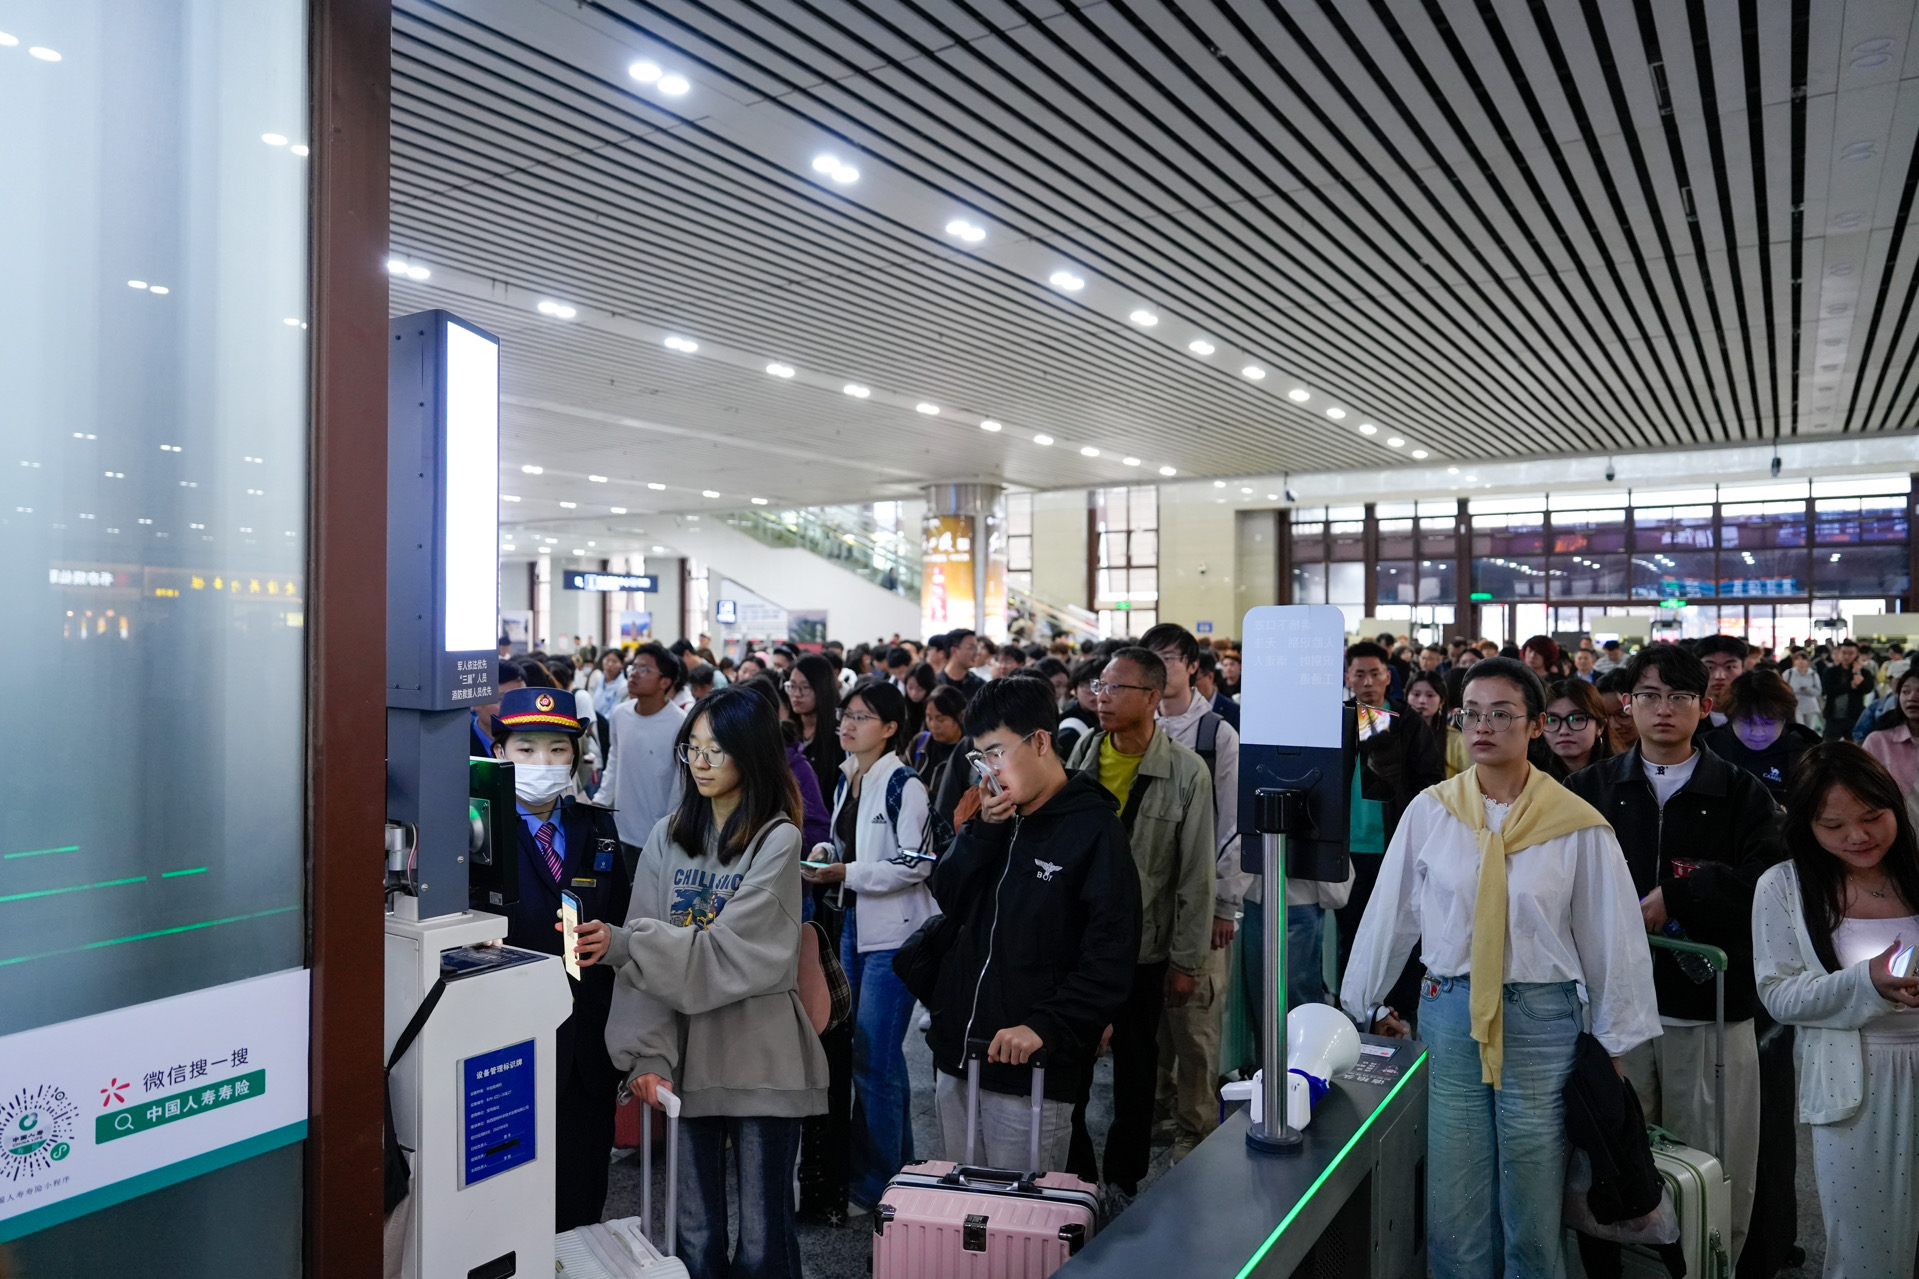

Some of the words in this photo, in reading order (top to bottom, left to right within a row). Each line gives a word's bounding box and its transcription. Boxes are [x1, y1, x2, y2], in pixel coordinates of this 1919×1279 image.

[457, 659, 488, 671] 军人依法优先
[451, 686, 493, 701] 消防救援人员优先
[143, 1047, 249, 1093] 微信搜一搜
[476, 1058, 523, 1080] 设备管理标识牌
[146, 1079, 250, 1122] 中国人寿寿险
